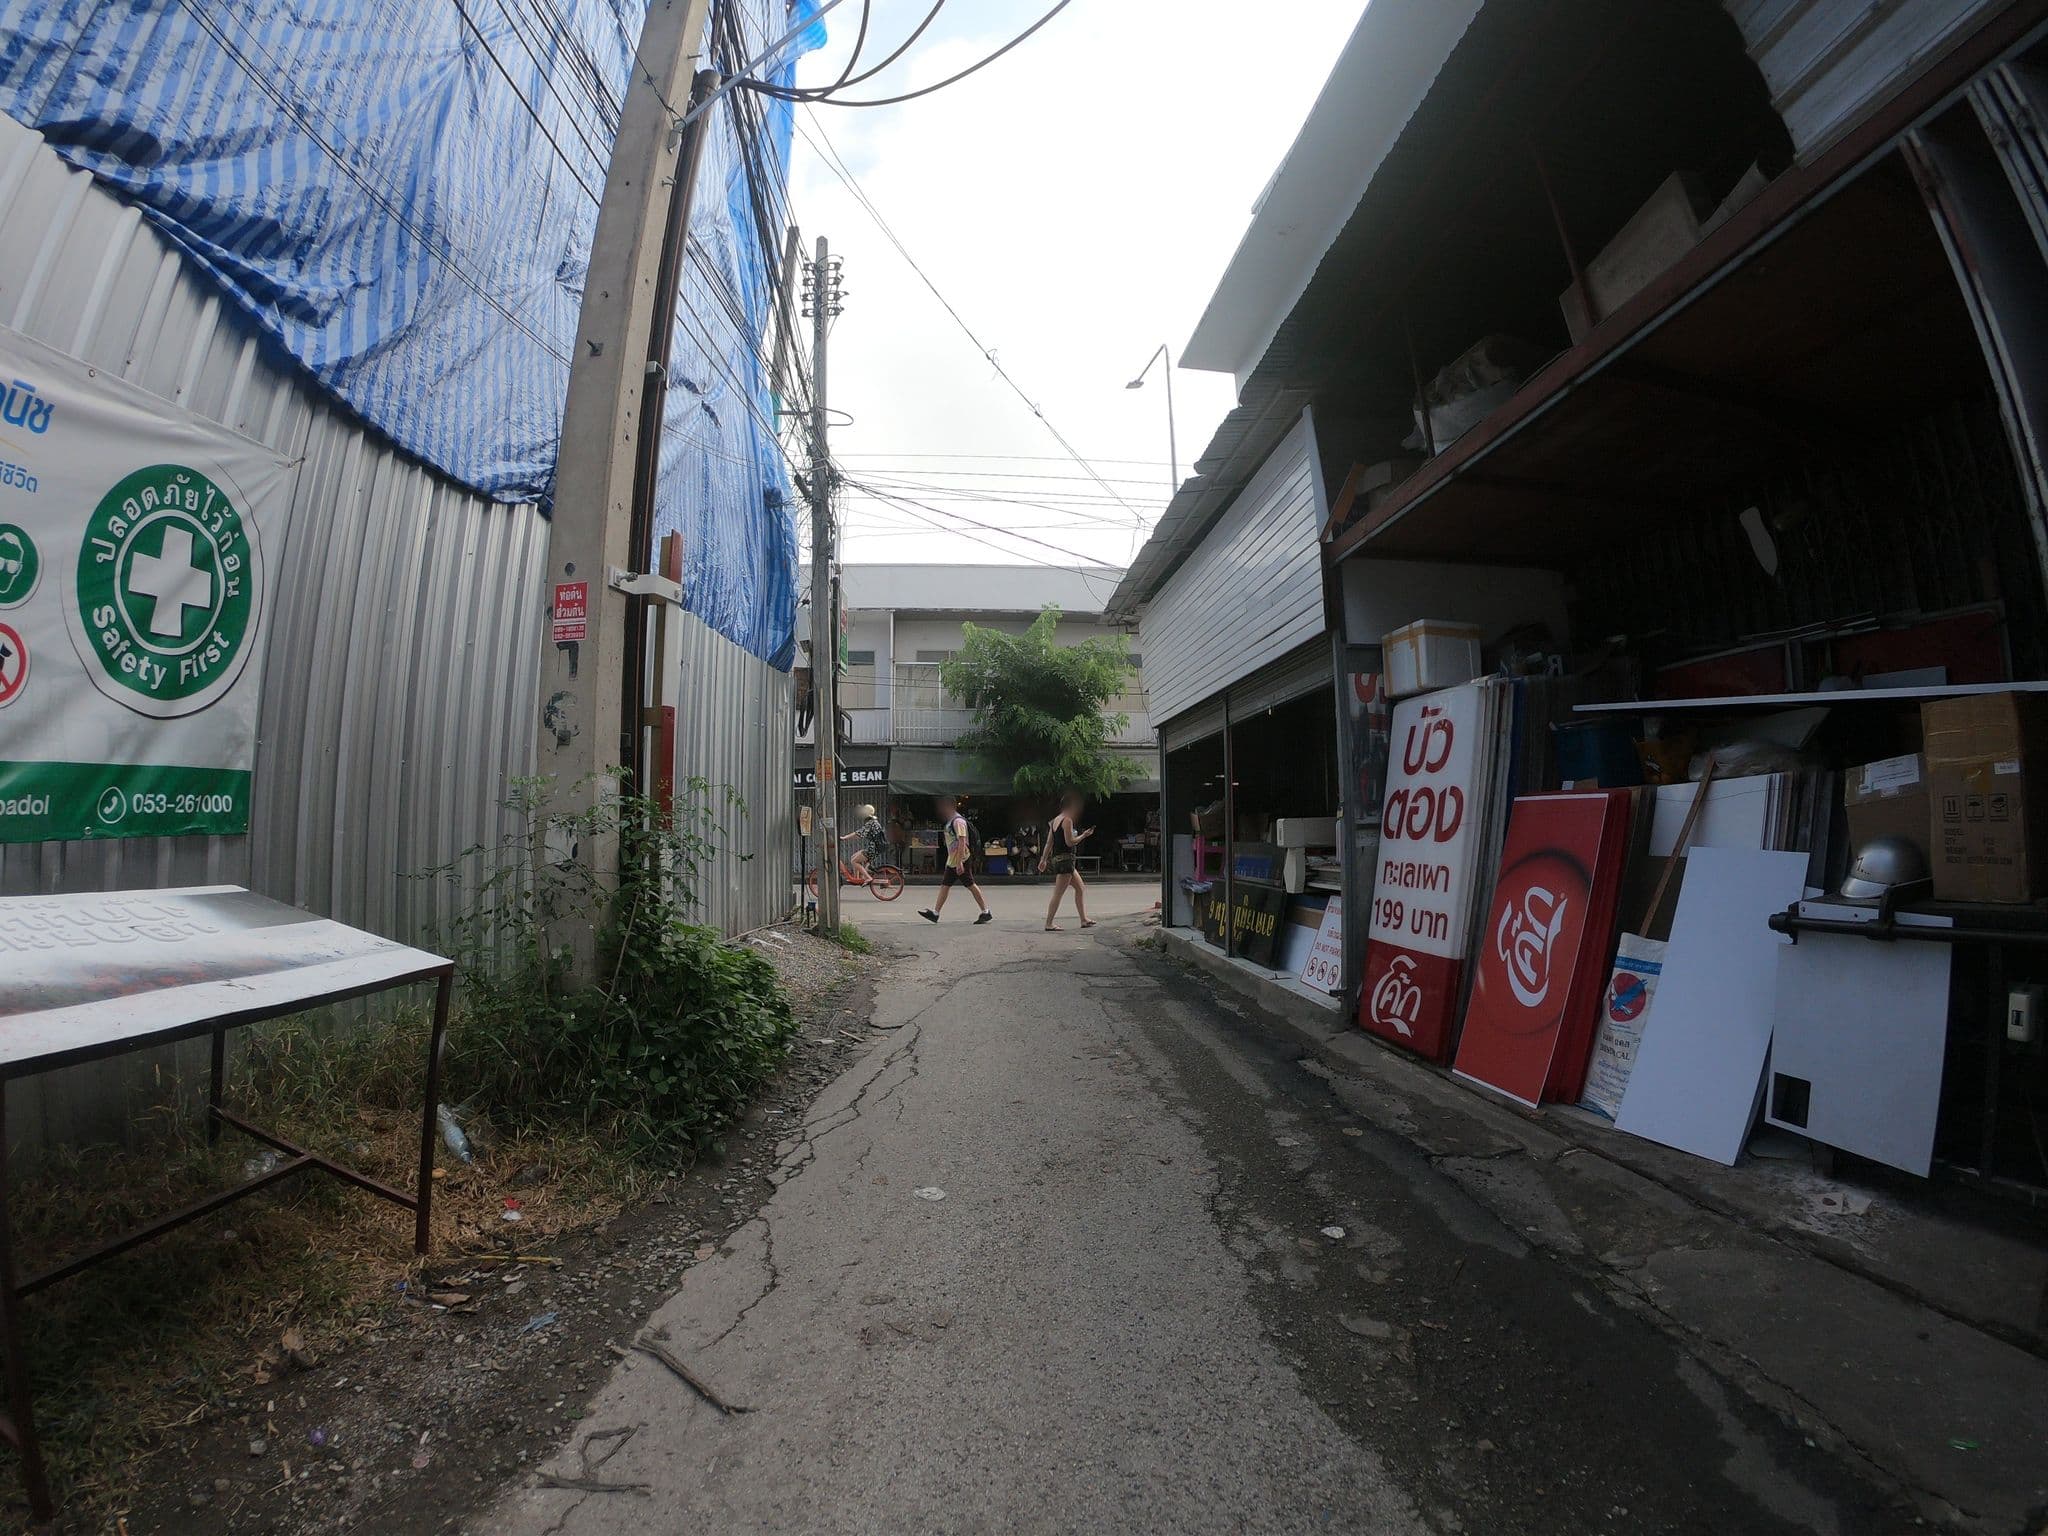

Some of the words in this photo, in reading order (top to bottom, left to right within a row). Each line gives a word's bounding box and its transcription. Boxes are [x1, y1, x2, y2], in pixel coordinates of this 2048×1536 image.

[94, 474, 243, 598] ปลอดภัยไว้ก่อน
[93, 604, 168, 690] Safety
[178, 629, 230, 687] First
[1403, 705, 1454, 776] บัว
[132, 793, 233, 814] 053-261000
[851, 770, 882, 782] BEAN
[1383, 785, 1464, 843] ตอง
[1375, 897, 1404, 930] 199
[1411, 908, 1449, 941] บาท
